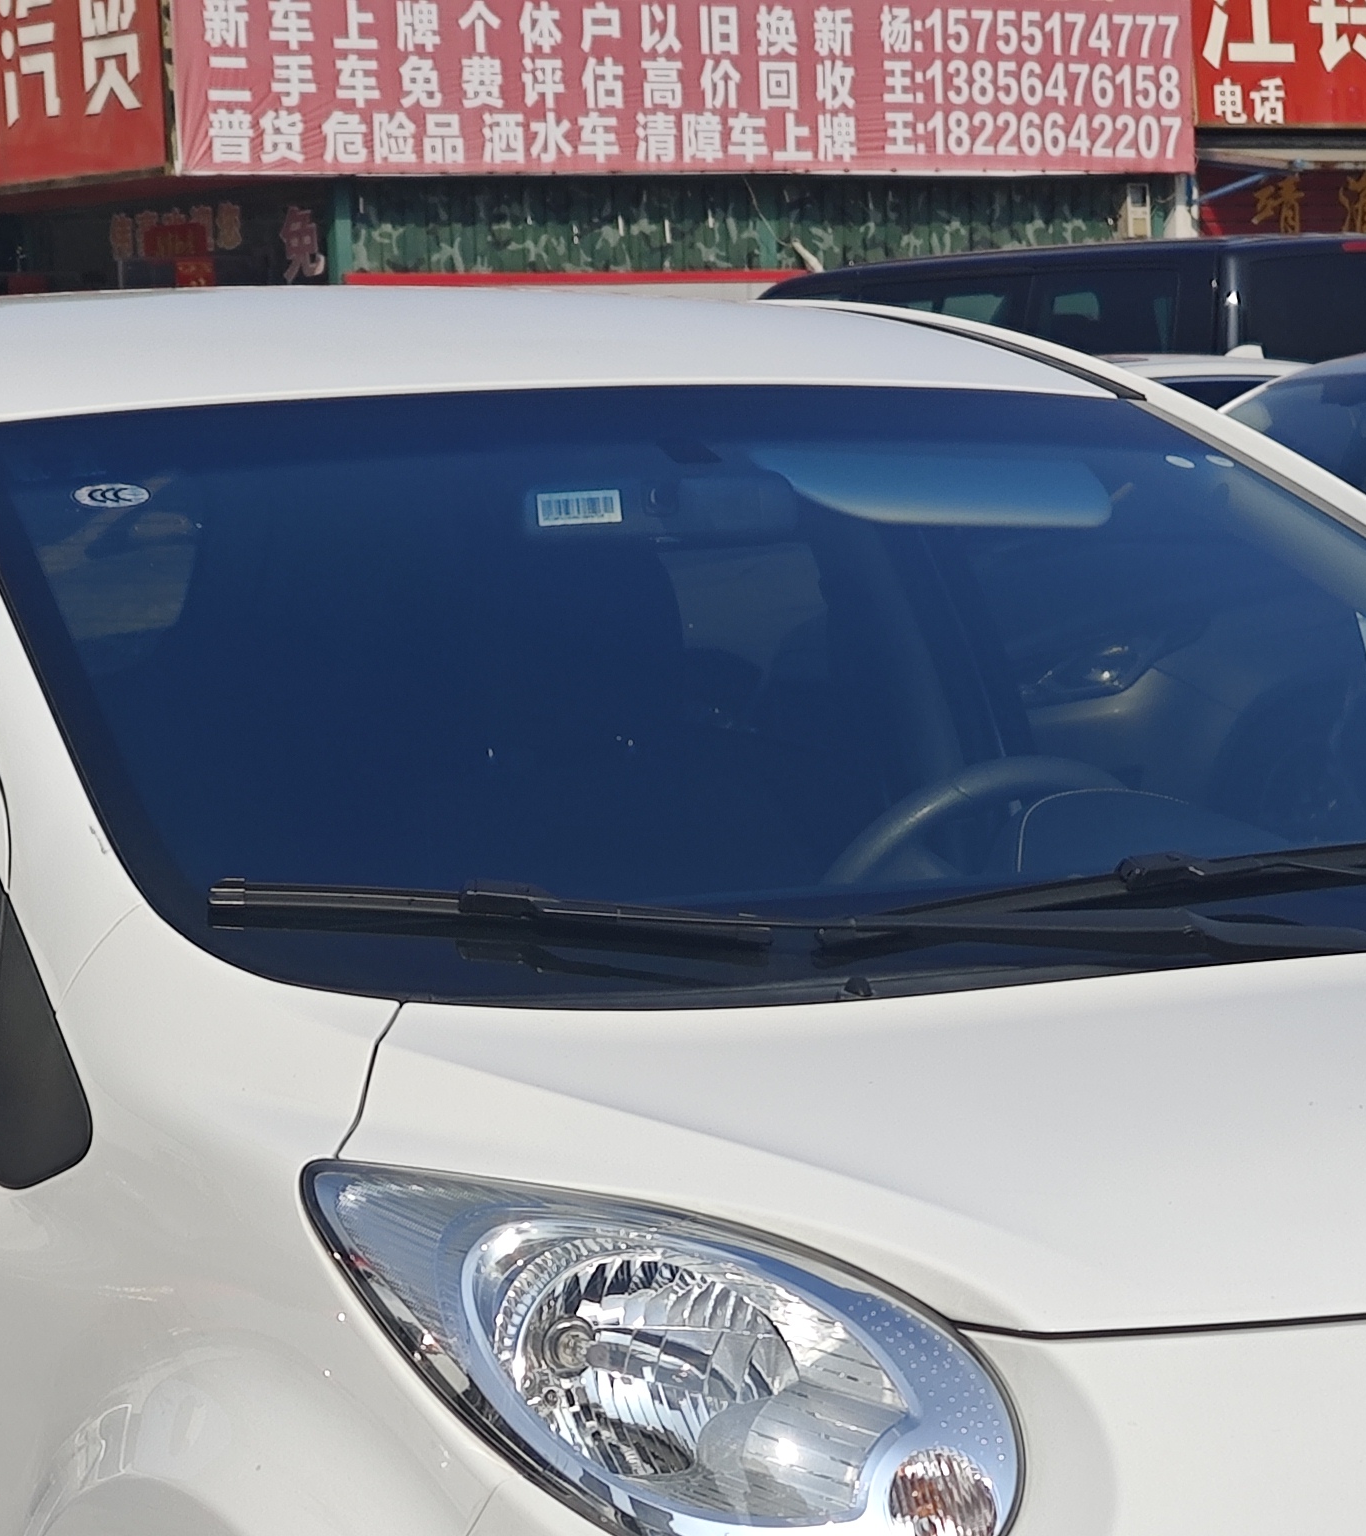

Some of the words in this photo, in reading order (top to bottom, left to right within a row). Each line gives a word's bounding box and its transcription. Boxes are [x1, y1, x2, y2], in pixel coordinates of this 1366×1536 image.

[206, 54, 856, 111] 二手车免费评估高价回收
[1213, 77, 1286, 125] 电话
